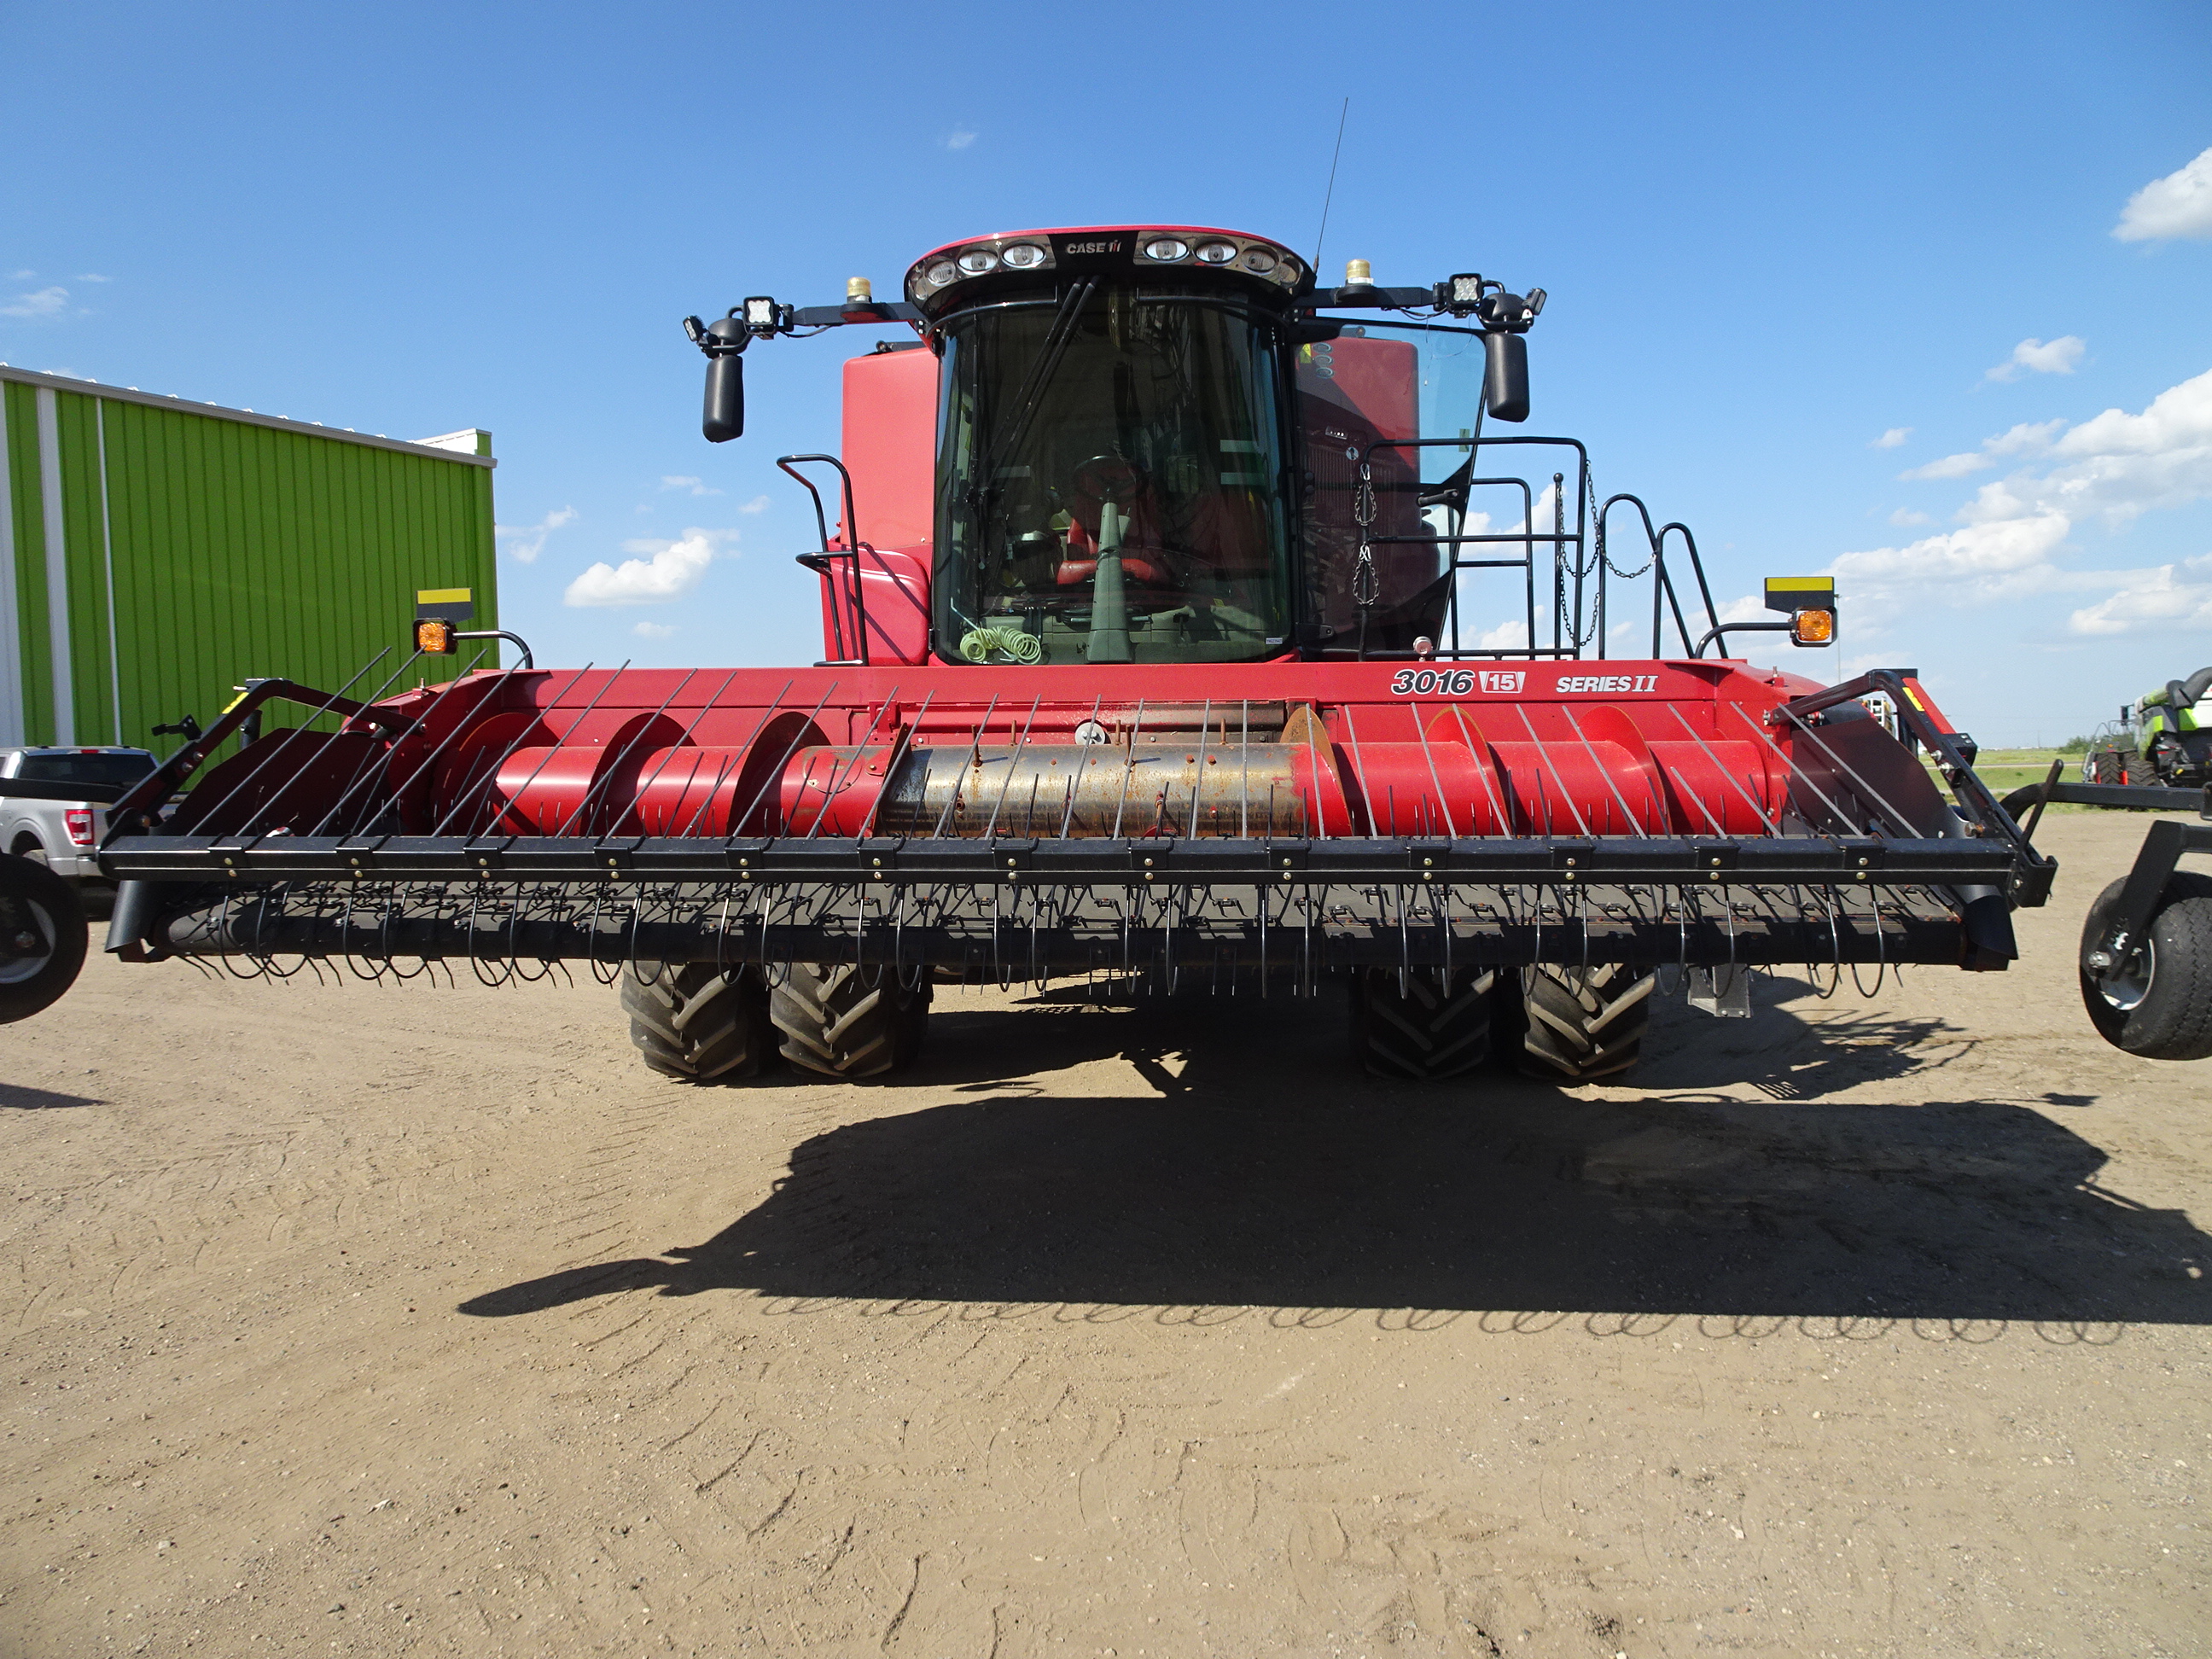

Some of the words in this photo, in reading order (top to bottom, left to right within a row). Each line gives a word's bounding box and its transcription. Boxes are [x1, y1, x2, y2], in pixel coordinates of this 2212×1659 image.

[1067, 242, 1106, 254] CASE
[1391, 669, 1476, 695] 3016
[1489, 674, 1515, 691] 15
[1556, 676, 1632, 693] SERIES
[1632, 675, 1658, 692] II
